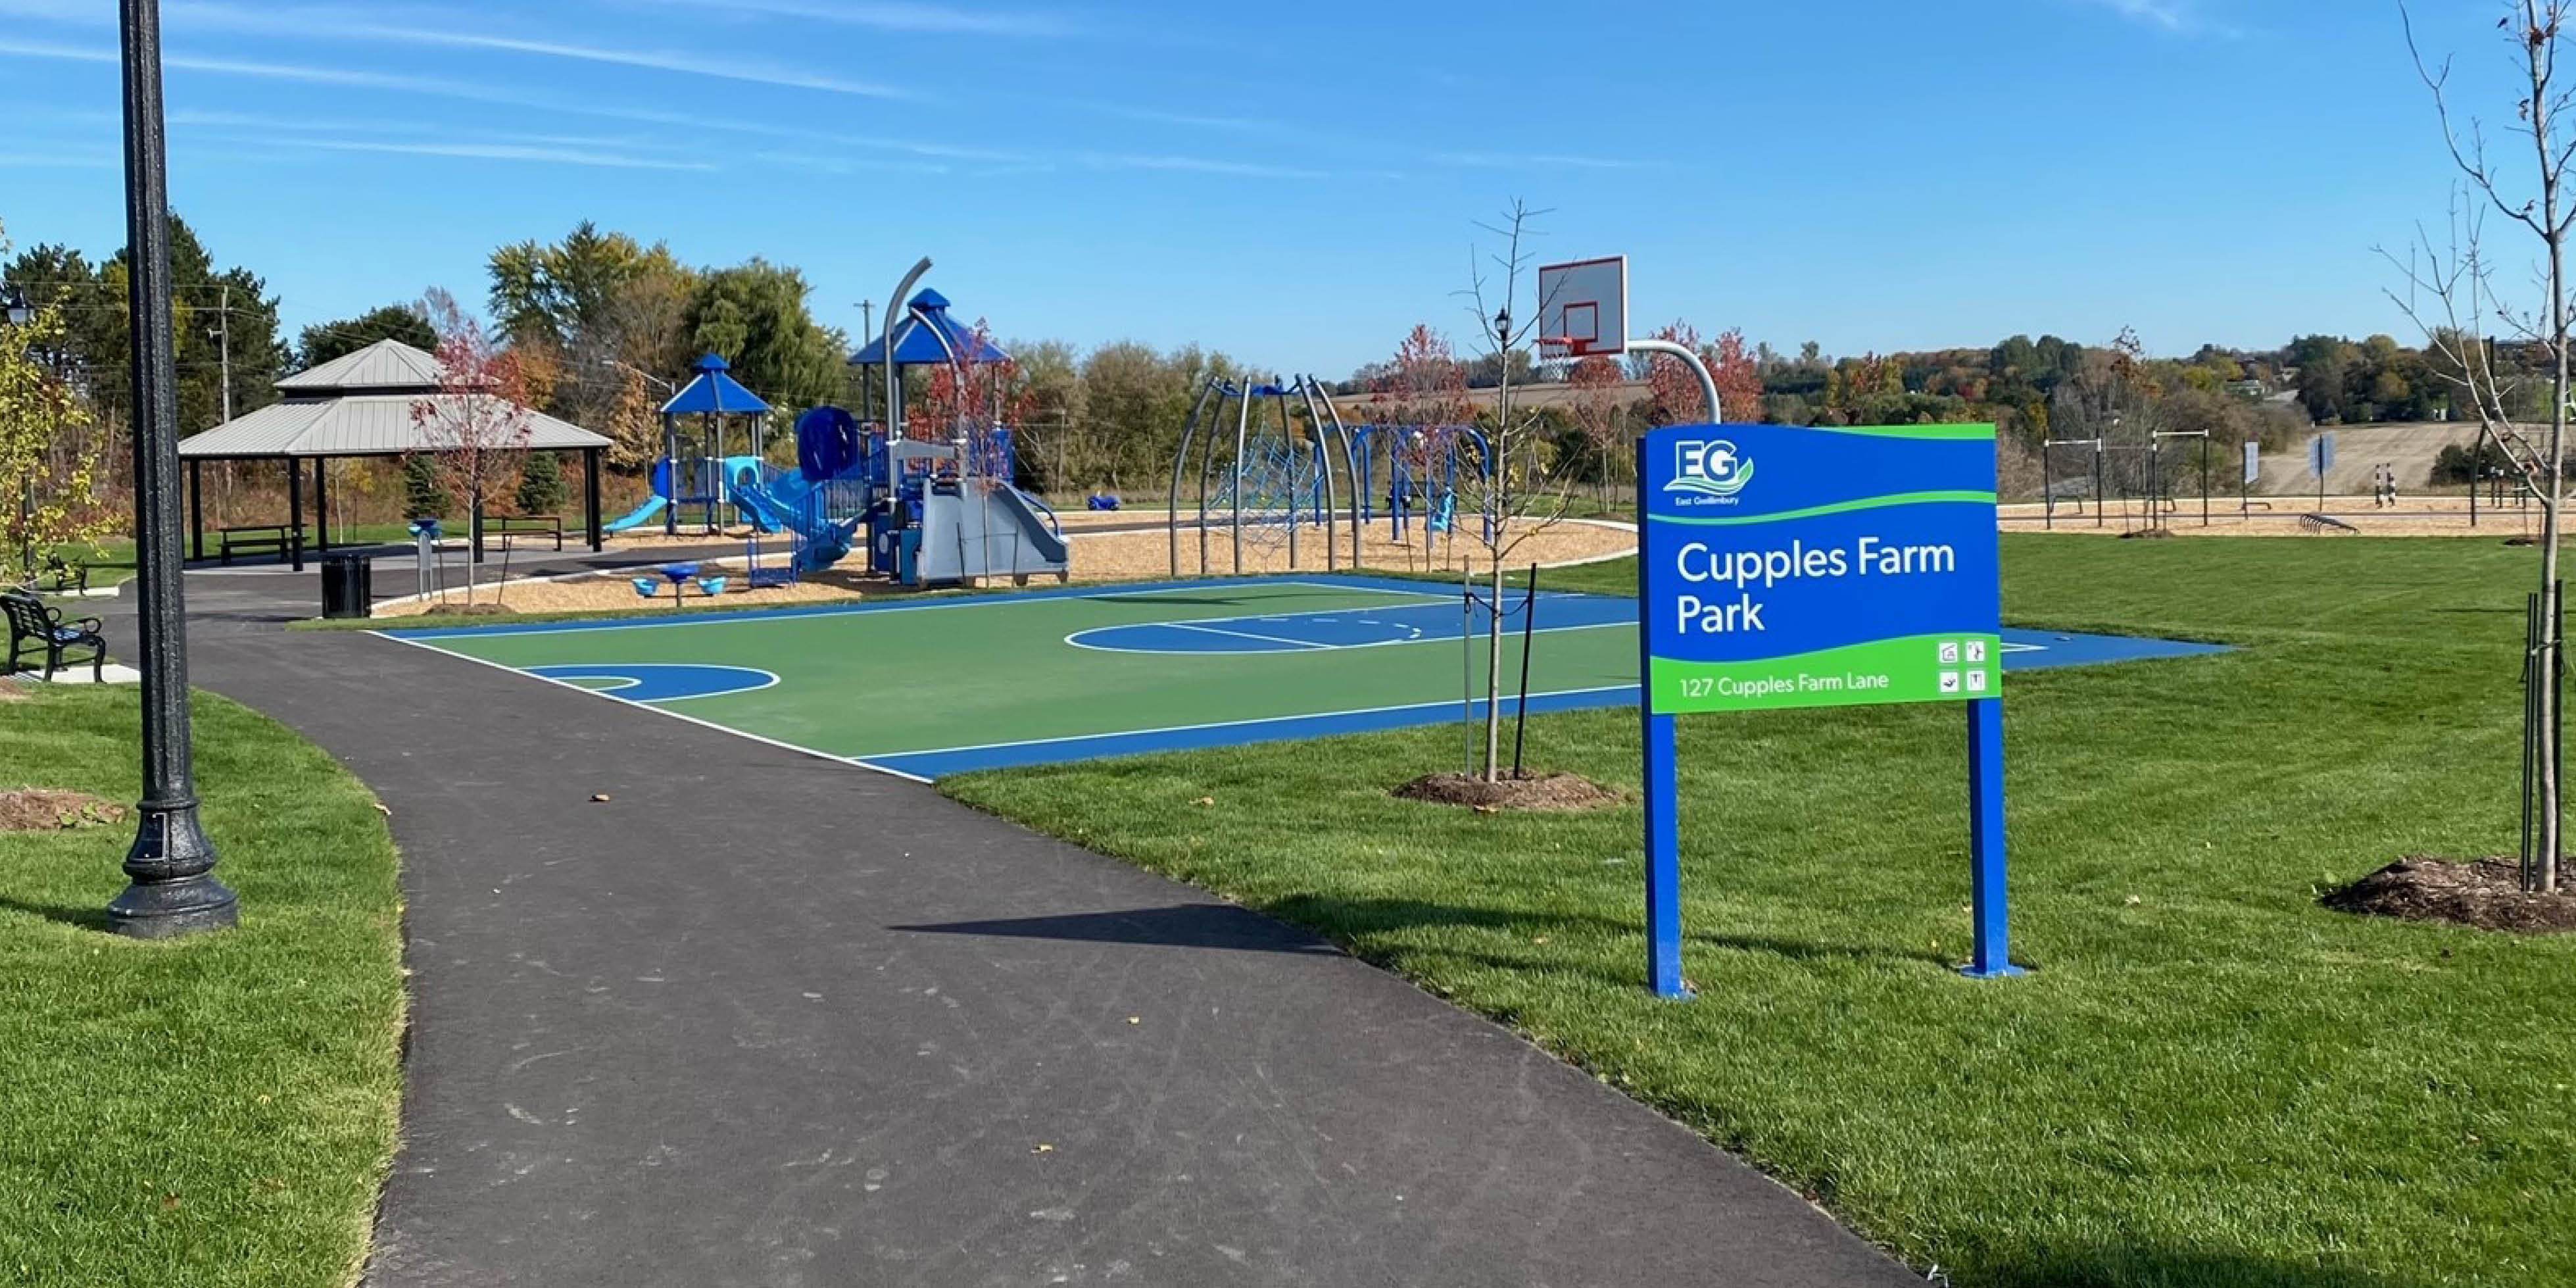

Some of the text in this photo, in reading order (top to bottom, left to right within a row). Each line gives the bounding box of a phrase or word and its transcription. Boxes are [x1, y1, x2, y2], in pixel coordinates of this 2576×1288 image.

[1676, 440, 1738, 482] EG
[1694, 496, 1739, 506] Gllbury
[1678, 537, 1955, 588] Cupples Farm
[1678, 594, 1765, 633] Park
[1680, 673, 1889, 697] 127 Cupples Farm Lane
